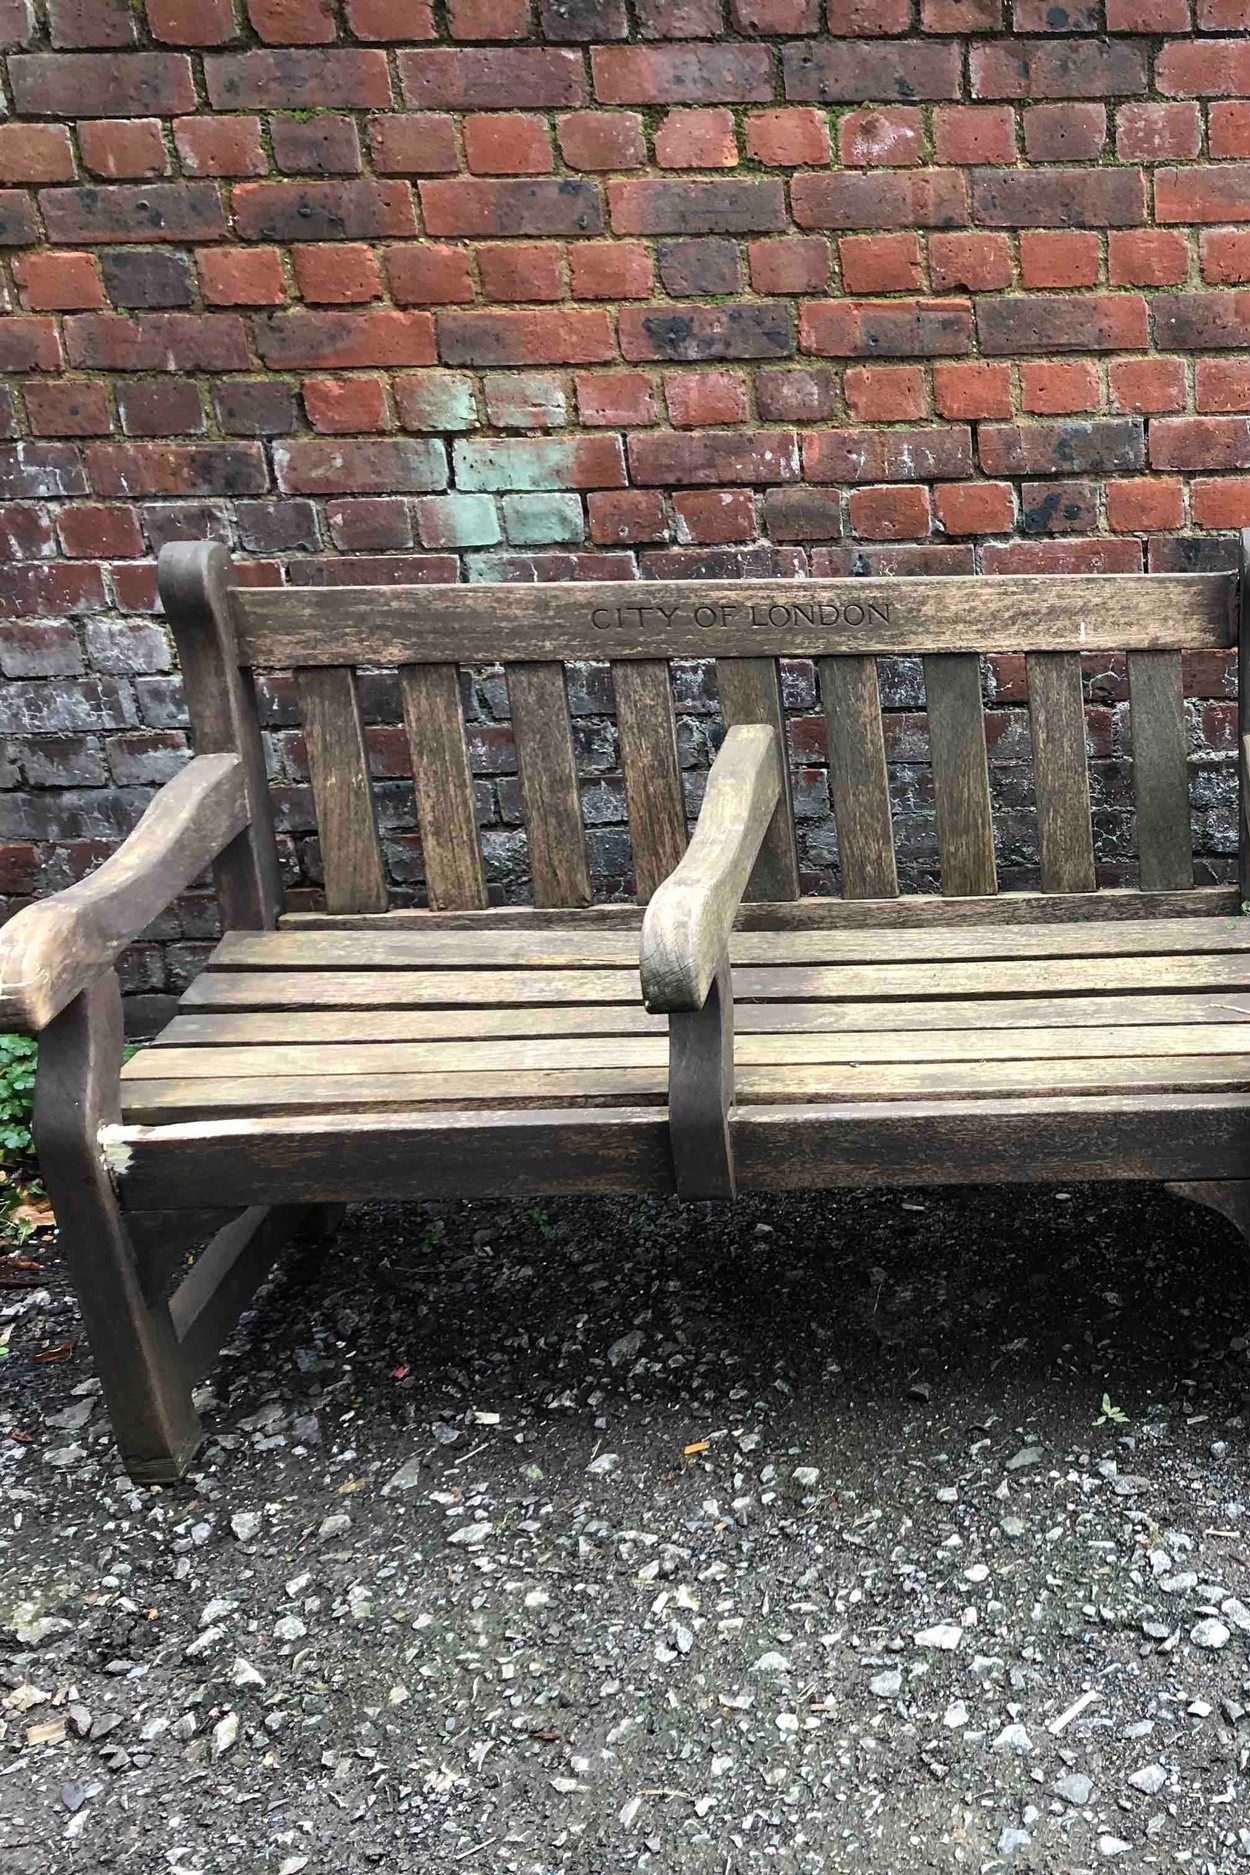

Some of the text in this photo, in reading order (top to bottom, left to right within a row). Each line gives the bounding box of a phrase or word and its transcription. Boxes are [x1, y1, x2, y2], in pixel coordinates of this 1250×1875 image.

[591, 603, 893, 630] CITY OF LONDON
